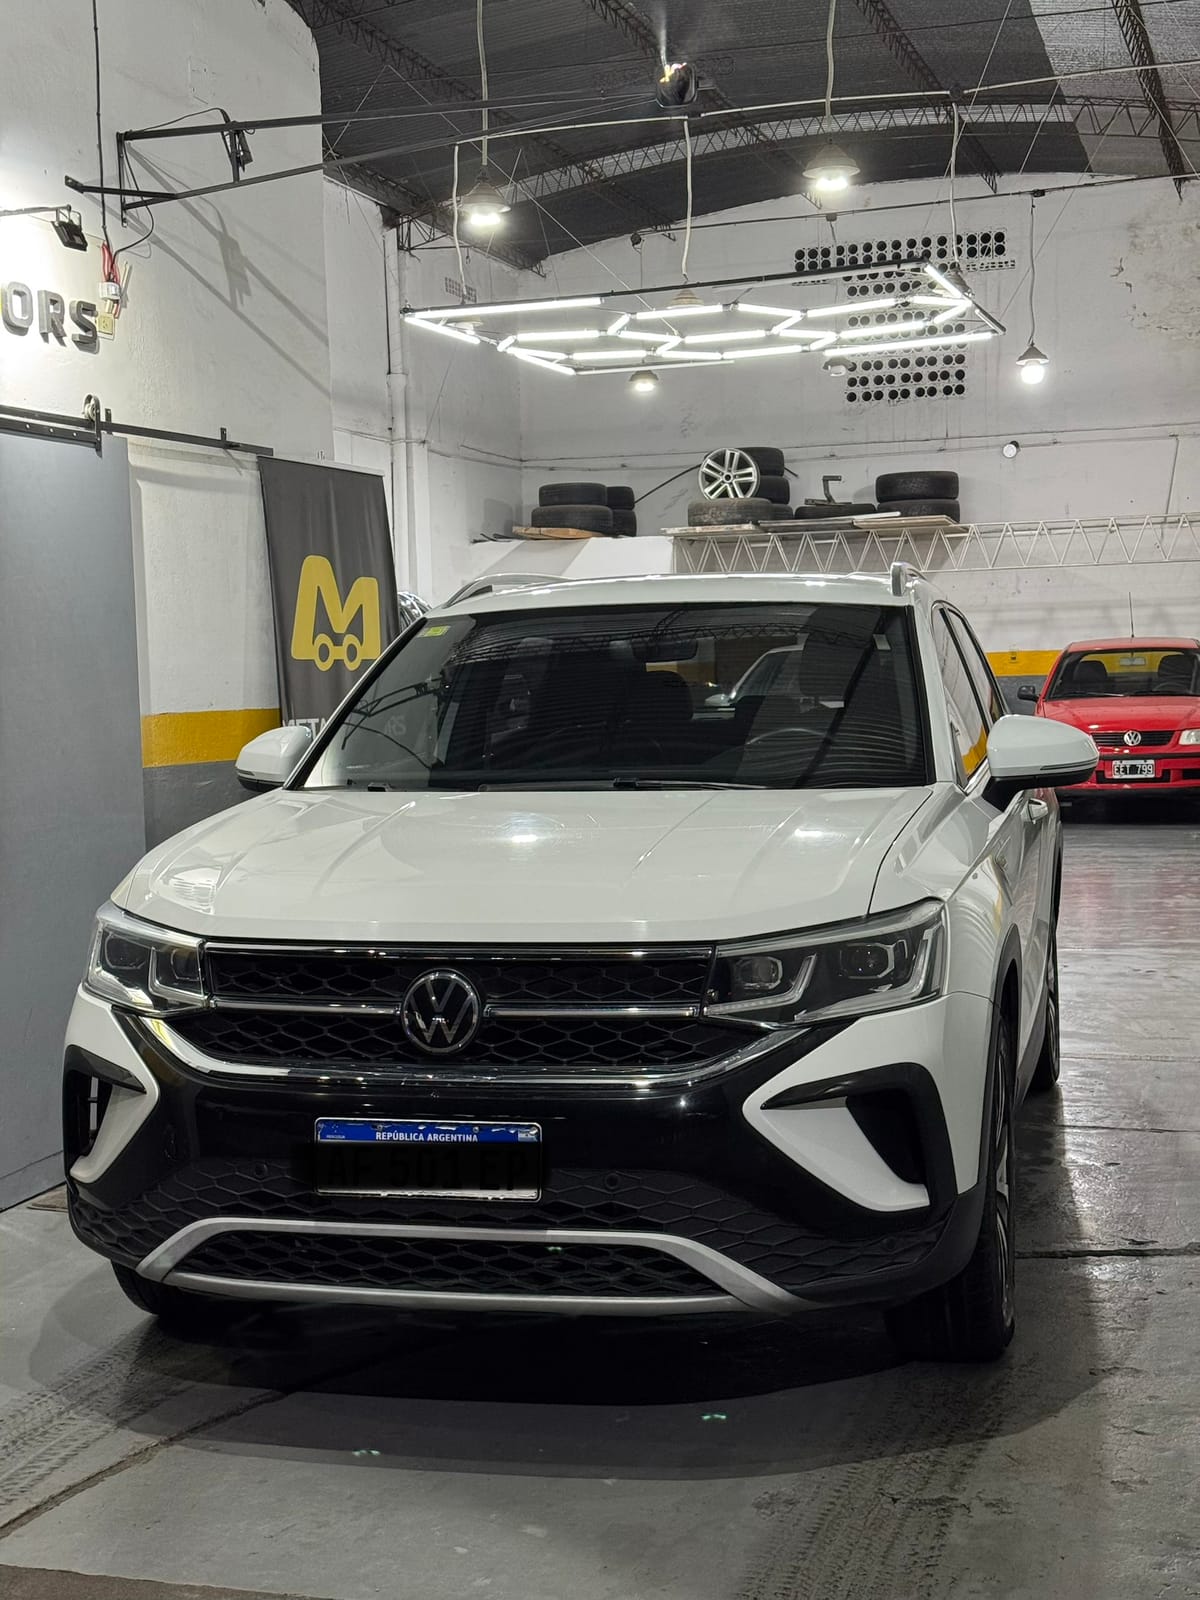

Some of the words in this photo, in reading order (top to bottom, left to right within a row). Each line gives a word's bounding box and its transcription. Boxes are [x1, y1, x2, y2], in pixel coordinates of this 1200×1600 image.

[2, 281, 98, 350] ORS
[375, 1130, 424, 1142] REPÚBLICA
[427, 1133, 478, 1143] ARGENTINA
